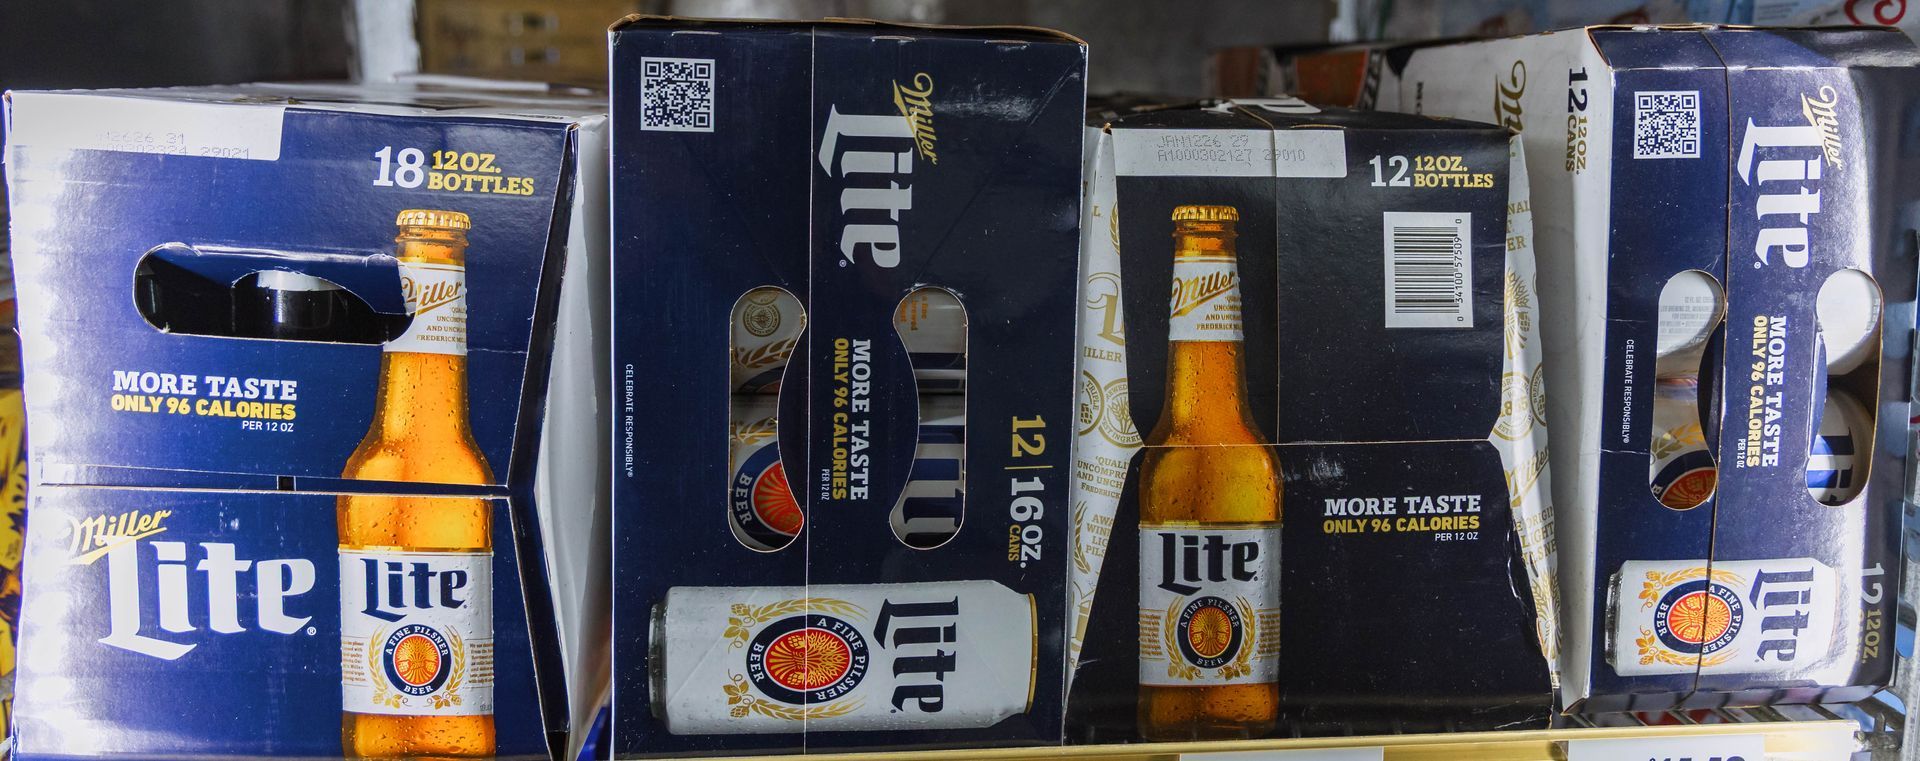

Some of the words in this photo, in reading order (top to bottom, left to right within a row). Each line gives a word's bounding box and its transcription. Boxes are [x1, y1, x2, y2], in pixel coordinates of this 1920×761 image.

[1568, 67, 1588, 113] 12
[893, 72, 938, 165] Miller
[1801, 85, 1842, 170] Miller
[1566, 115, 1577, 172] CANS
[373, 146, 425, 189] 18
[432, 150, 502, 174] 12OZ.
[1369, 155, 1411, 187] 12
[1414, 155, 1468, 172] 12OZ.
[1414, 173, 1494, 188] BOTTLES
[427, 172, 534, 196] BOTTLES
[1454, 237, 1463, 268] 57509
[1171, 270, 1235, 319] Miller
[1454, 272, 1464, 303] 34100
[1752, 315, 1768, 359] ONLY
[1766, 315, 1787, 386] MORE
[834, 338, 849, 384] ONLY
[851, 339, 871, 413] MORE
[1624, 339, 1635, 385] CELEBRATE
[1751, 361, 1766, 382] 96
[112, 370, 197, 395] MORE
[206, 376, 297, 400] TASTE
[625, 363, 634, 413] CELEBRATE
[833, 386, 849, 408] 96
[111, 394, 163, 413] ONLY
[166, 398, 191, 415] 96
[195, 399, 296, 421] CALORIES
[242, 420, 263, 431] PER
[265, 422, 277, 432] 12
[280, 422, 294, 433] OZ
[1011, 415, 1046, 458] 12
[1746, 385, 1764, 468] CALORIES
[1762, 391, 1783, 467] TASTE
[832, 412, 848, 500] CALORIES
[850, 420, 870, 500] TASTE
[1736, 451, 1745, 460] 12
[1737, 438, 1746, 451] PER
[821, 468, 830, 482] PER
[1076, 470, 1094, 481] AND
[1736, 460, 1745, 469] OZ
[735, 472, 753, 525] BEER
[821, 483, 830, 492] 12
[821, 492, 830, 501] OZ
[1324, 497, 1397, 516] MORE
[1404, 494, 1481, 514] TASTE
[63, 510, 172, 565] Miller
[1323, 518, 1368, 534] ONLY
[1371, 517, 1392, 533] 96
[1396, 515, 1480, 532] CALORIES
[1434, 532, 1452, 541] PER
[1455, 532, 1465, 541] 12
[1467, 531, 1479, 540] OZ
[1007, 524, 1021, 562] CANS
[1184, 600, 1205, 620] FINE
[1208, 598, 1240, 628] PILSNER
[1719, 588, 1740, 612] FINE
[816, 617, 827, 627] A
[833, 621, 864, 649] FINE
[1656, 602, 1670, 637] BEER
[1702, 614, 1742, 654] PILSNER
[385, 648, 393, 656] A
[390, 627, 412, 647] FINE
[414, 625, 450, 656] PILSNER
[749, 642, 765, 683] BEER
[1196, 657, 1224, 667] BEER
[403, 685, 434, 695] BEER
[816, 655, 866, 701] PILSNER
